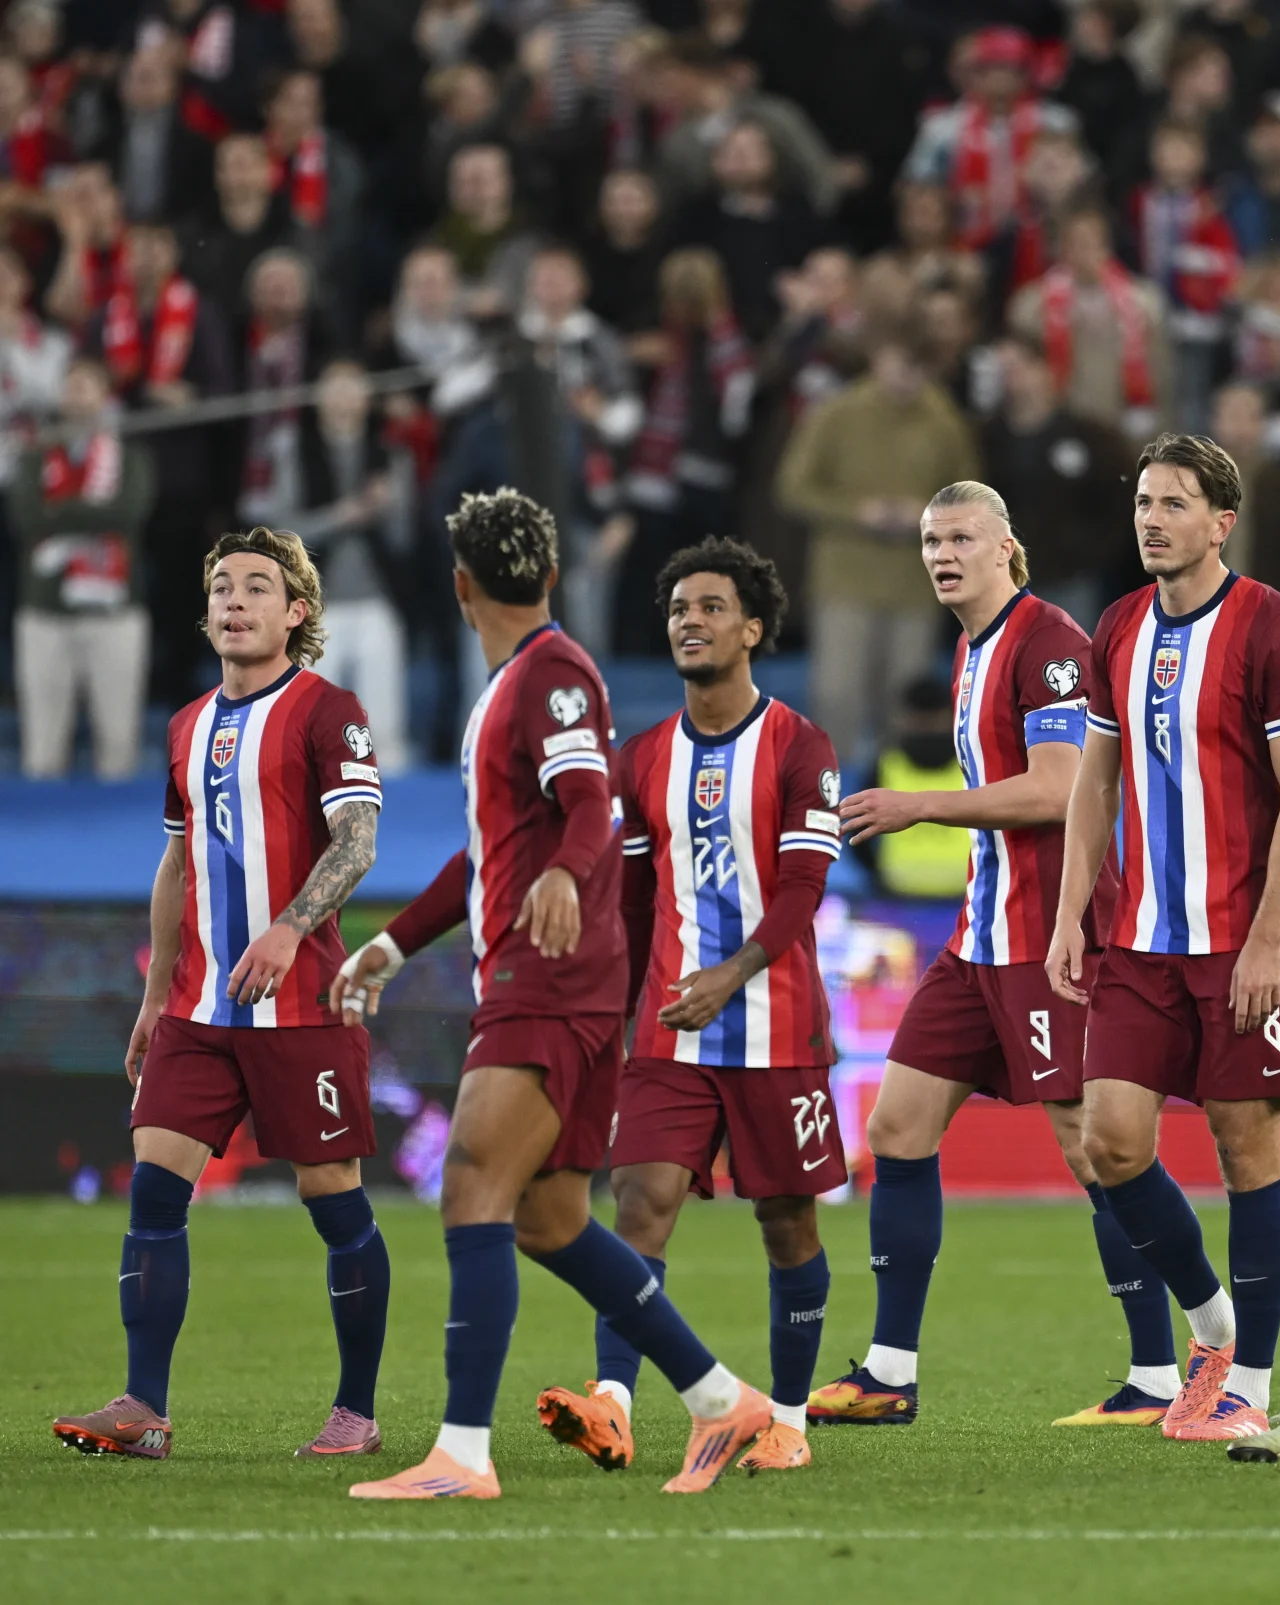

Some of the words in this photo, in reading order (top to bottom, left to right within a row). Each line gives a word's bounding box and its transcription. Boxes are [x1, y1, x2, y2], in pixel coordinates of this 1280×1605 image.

[1154, 713, 1172, 766] 8
[215, 792, 234, 846] 6
[693, 835, 737, 891] 22
[1029, 1010, 1052, 1061] 9
[316, 1069, 341, 1120] 6
[790, 1089, 831, 1151] 22
